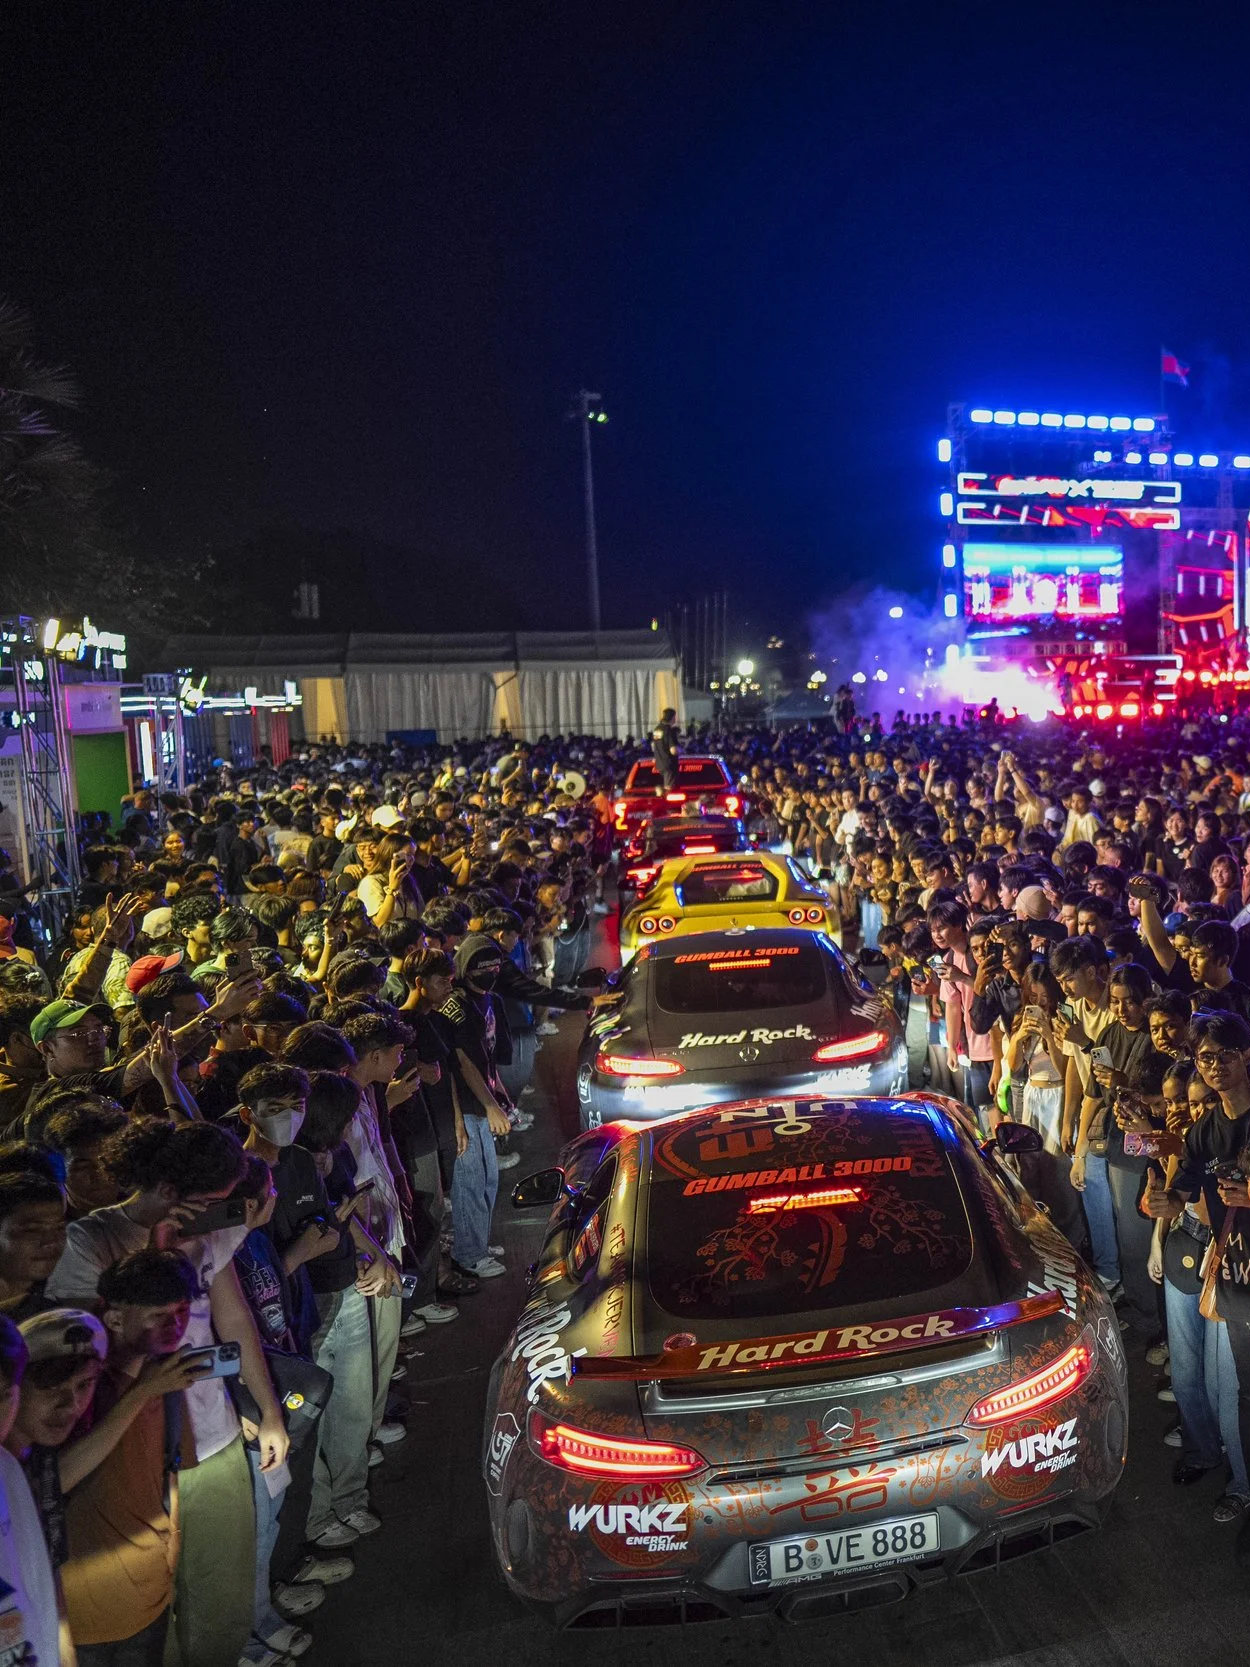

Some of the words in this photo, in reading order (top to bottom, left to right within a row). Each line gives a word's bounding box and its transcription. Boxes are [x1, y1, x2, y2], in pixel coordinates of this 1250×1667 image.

[674, 949, 751, 964] GUMBALL
[753, 947, 800, 956] 3000
[678, 1030, 748, 1049] Hard
[682, 1165, 827, 1197] GUMBALL
[833, 1156, 913, 1177] 3000
[696, 1330, 830, 1371] Hard
[836, 1315, 955, 1350] Rock
[980, 1417, 1080, 1479] WURKZ
[1034, 1450, 1071, 1473] ENERGY
[1050, 1454, 1078, 1473] DRINK
[567, 1502, 690, 1534] WURKZ
[626, 1535, 676, 1546] ENERGY
[647, 1541, 689, 1552] DRINK
[784, 1544, 804, 1574] B
[825, 1532, 865, 1566] VE
[871, 1521, 927, 1557] 888
[833, 1564, 873, 1577] Performance
[873, 1559, 896, 1571] Center
[896, 1553, 926, 1564] Frankfurt
[786, 1572, 823, 1585] AMG
